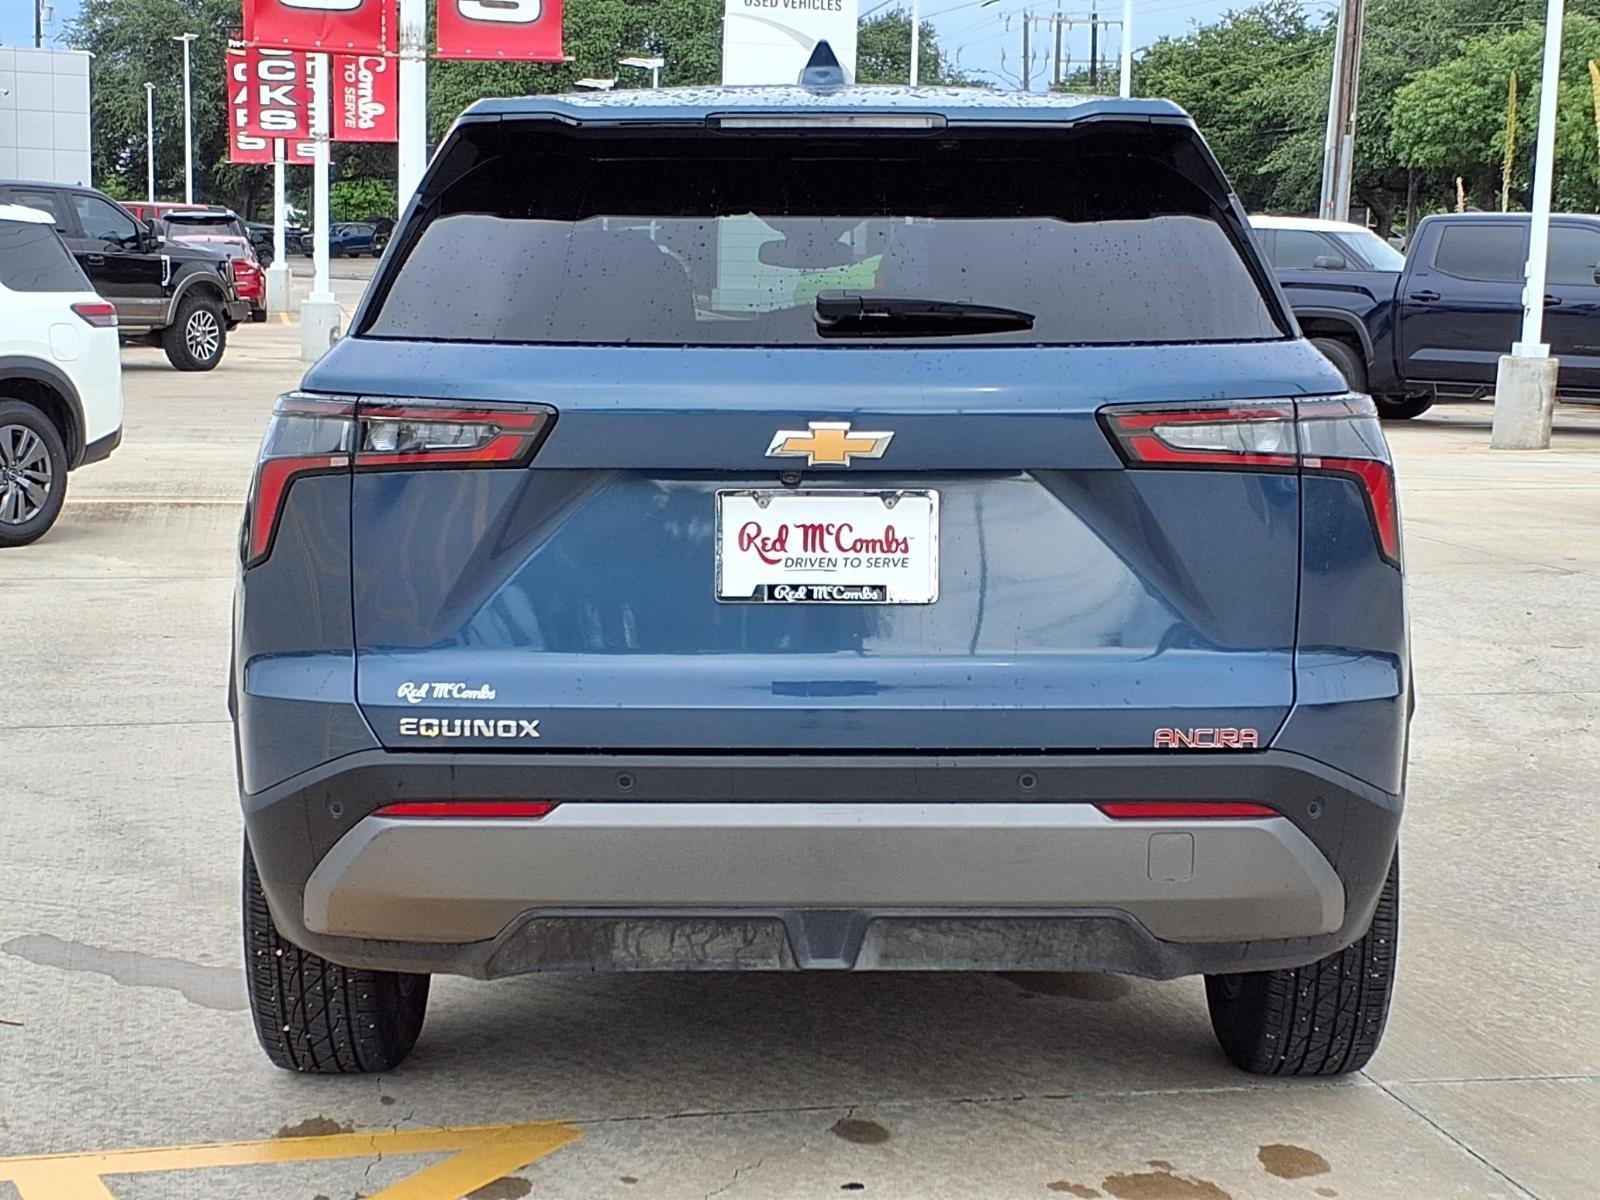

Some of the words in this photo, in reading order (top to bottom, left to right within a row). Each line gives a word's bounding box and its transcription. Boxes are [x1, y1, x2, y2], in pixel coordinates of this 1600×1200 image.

[783, 0, 842, 11] VEHICLES
[344, 63, 356, 83] TO
[344, 86, 356, 128] SERVE
[738, 521, 790, 565] Red
[794, 523, 909, 554] McCombs
[784, 557, 838, 569] DRIVEN
[843, 557, 862, 568] TO
[866, 557, 910, 568] SERVE
[774, 585, 807, 602] Red
[808, 585, 878, 600] McCombs
[397, 682, 429, 703] Red
[431, 682, 496, 700] McCombs
[400, 717, 540, 738] EQUINOX
[1153, 727, 1259, 748] ANCIRA
